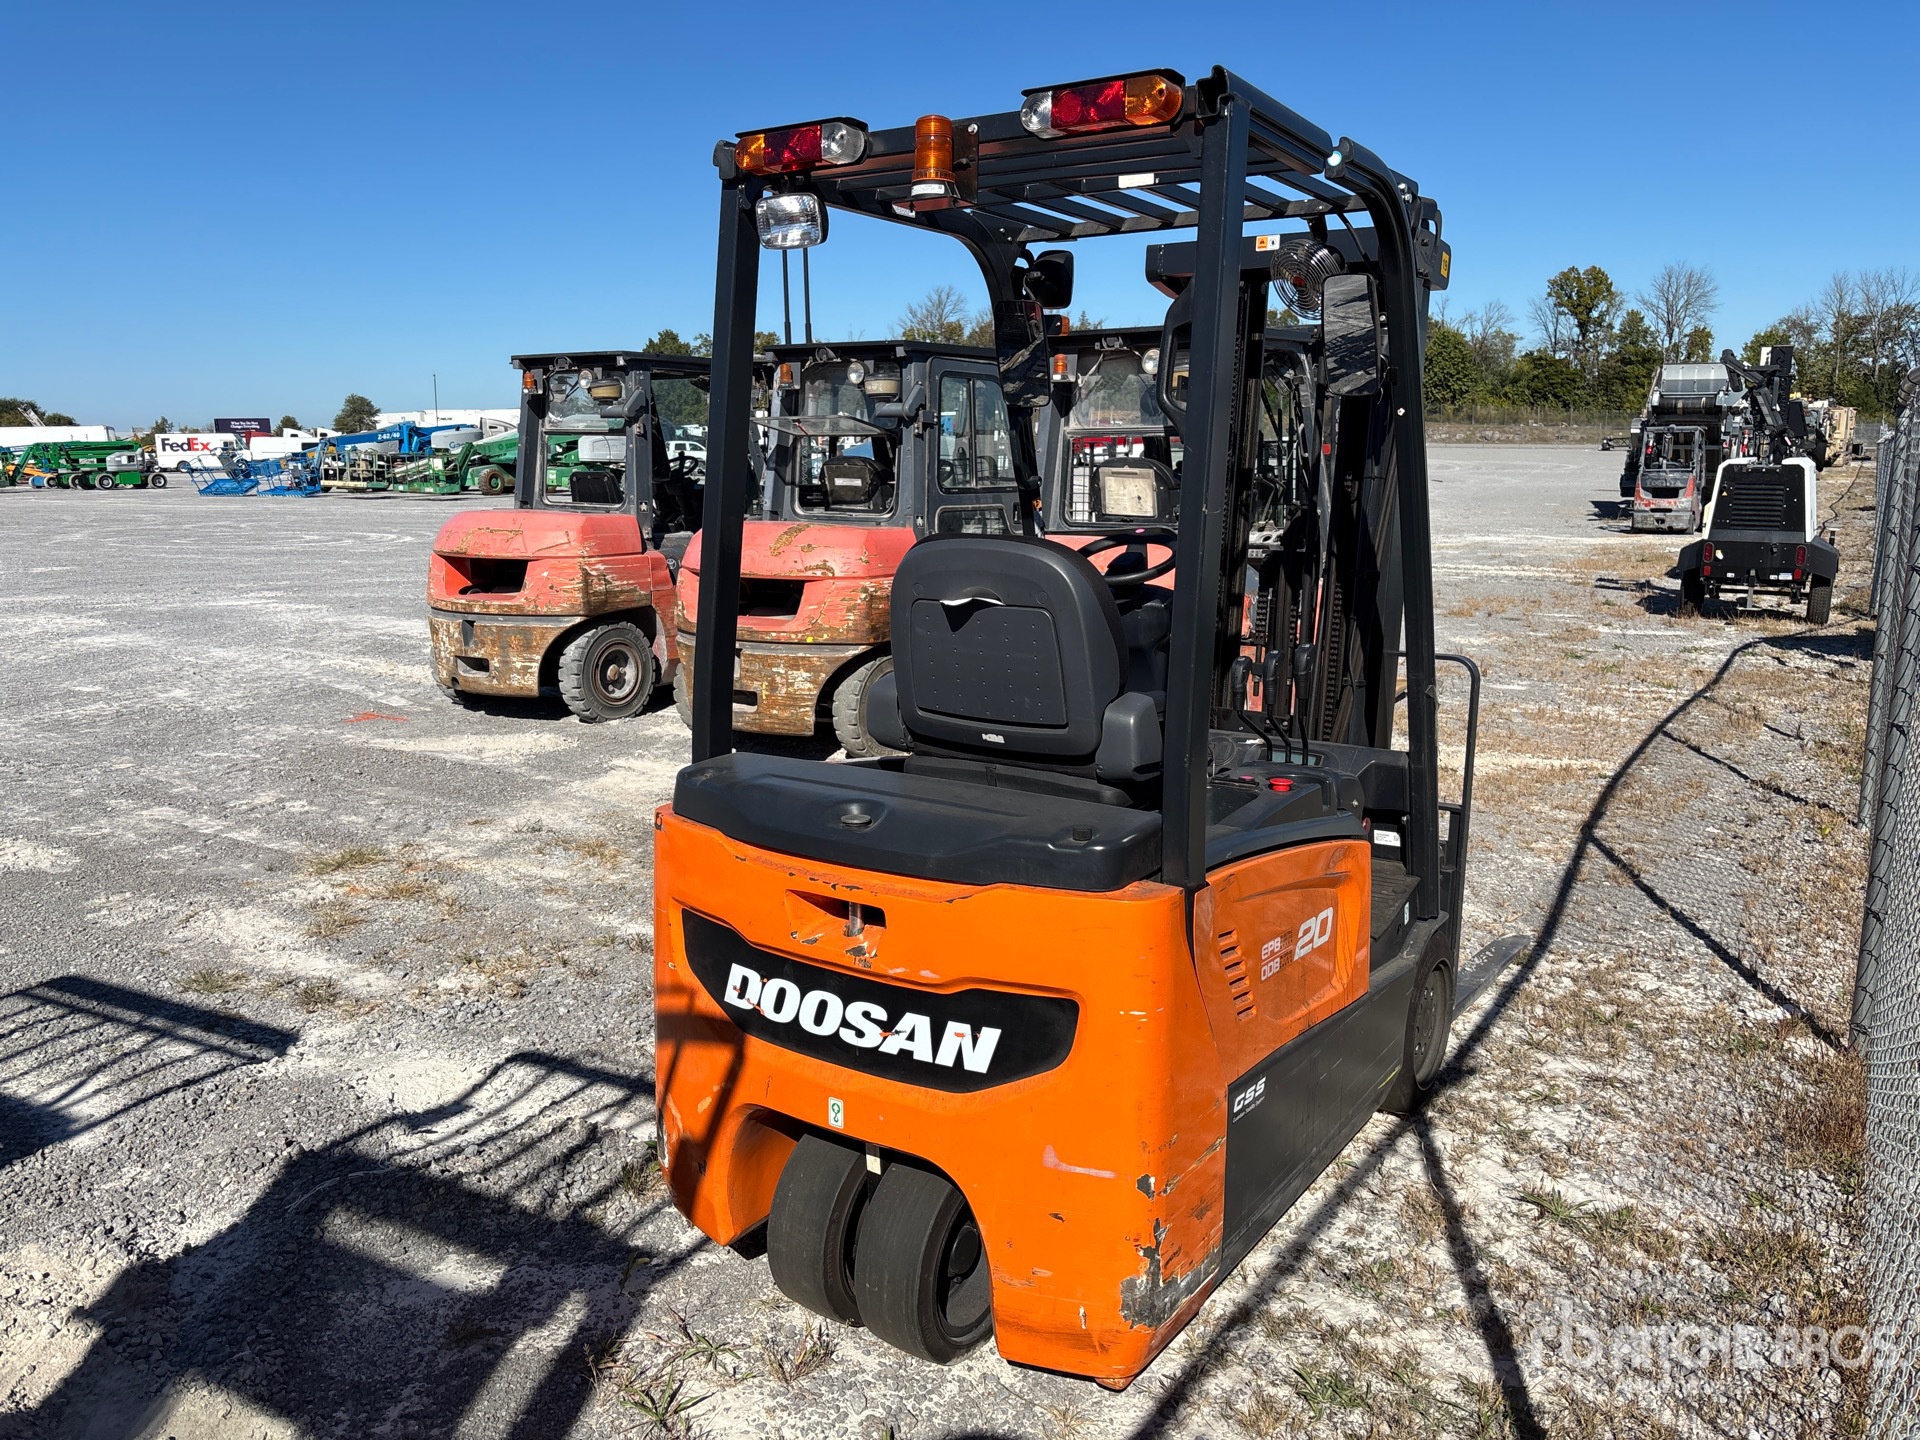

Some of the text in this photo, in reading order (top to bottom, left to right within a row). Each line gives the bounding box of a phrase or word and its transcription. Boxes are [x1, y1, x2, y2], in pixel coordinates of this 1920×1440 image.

[161, 437, 212, 452] FedEx
[1261, 936, 1281, 960] EPB
[1293, 906, 1334, 961] 20
[1260, 957, 1281, 981] ODB
[724, 962, 1002, 1074] DOOSAN
[1233, 1076, 1267, 1114] GSS
